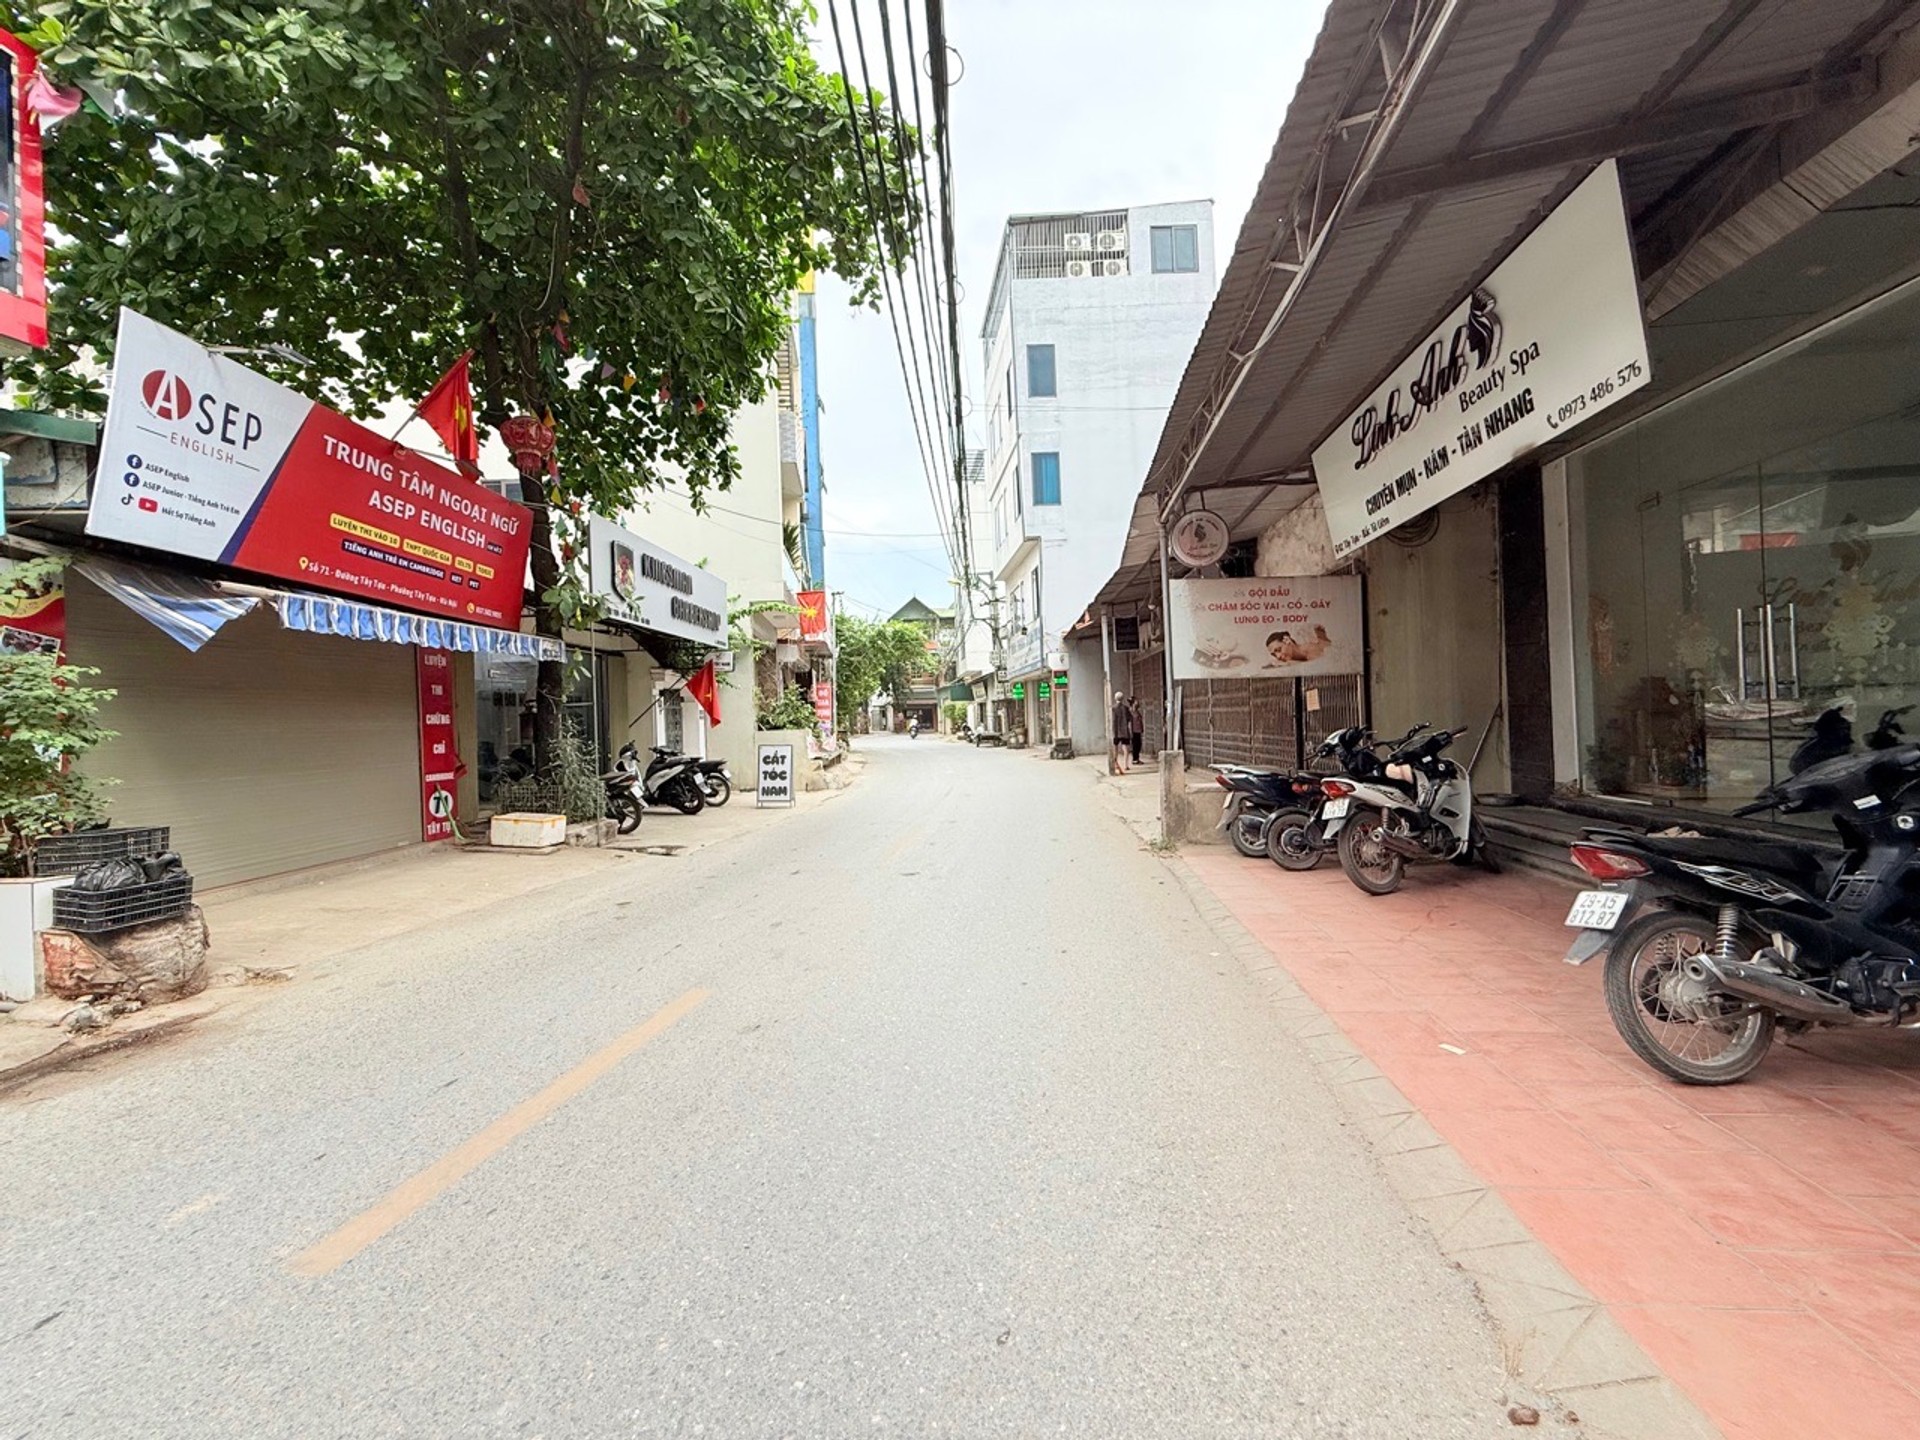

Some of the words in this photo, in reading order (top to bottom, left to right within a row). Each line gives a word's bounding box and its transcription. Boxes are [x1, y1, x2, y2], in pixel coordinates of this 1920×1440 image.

[1458, 365, 1506, 413] Beauty
[1509, 341, 1540, 376] Spa
[1352, 388, 1400, 470] Linh
[1400, 324, 1468, 432] Anh
[1558, 395, 1587, 422] 0973
[1589, 377, 1614, 402] 486
[1616, 359, 1642, 388] 576
[150, 368, 262, 450] ASEP
[170, 432, 234, 465] ENGLISH
[1365, 482, 1397, 516] CHUYÊN
[1395, 468, 1418, 496] MỤN
[1423, 445, 1450, 479] NÁM
[1456, 426, 1484, 456] TÀN
[1483, 387, 1535, 440] NHANG
[145, 463, 164, 474] ASEP
[164, 469, 190, 482] English
[323, 435, 394, 482] TRUNG
[399, 470, 435, 500] TÂM
[439, 489, 487, 523] NGOẠI
[490, 512, 520, 536] NGỮ
[142, 480, 161, 492] ASEP
[162, 487, 184, 499] Junior
[188, 493, 206, 506] Tiếng
[207, 500, 219, 509] Anh
[230, 506, 241, 515] Em
[184, 513, 203, 526] Tiếng
[203, 519, 216, 528] Anh
[369, 491, 416, 520] ASEP
[420, 511, 486, 548] ENGLISH
[333, 517, 358, 532] LUYỆN
[359, 526, 373, 536] THI
[373, 531, 388, 542] VÀO
[389, 536, 398, 545] 10
[344, 541, 368, 555] TIẾNG
[368, 549, 384, 560] ANH
[385, 553, 397, 564] TRẺ
[398, 558, 408, 567] EM
[409, 560, 445, 578] CAMBRIDGE
[406, 541, 422, 553] THPT
[422, 546, 439, 560] QUỐC
[439, 554, 450, 563] GIA
[308, 562, 319, 573] Số
[320, 565, 330, 576] 71
[335, 569, 359, 585] Đường
[360, 575, 373, 589] Tây
[390, 583, 414, 599] Phường
[1248, 588, 1267, 600] GỘI
[1269, 585, 1290, 597] ĐẦU
[1208, 601, 1238, 611] CHĂM
[1240, 599, 1261, 611] SÓC
[1264, 601, 1280, 610] VAI
[1287, 597, 1303, 610] CỔ
[1234, 614, 1260, 625] LƯNG
[1262, 615, 1275, 624] EO
[1283, 614, 1308, 624] BODY
[424, 654, 447, 669] LUYỆN
[431, 684, 443, 696] THI
[426, 712, 451, 725] CHỨNG
[433, 740, 446, 754] CHỈ
[762, 750, 787, 765] CẮT
[762, 767, 787, 781] TÓC
[761, 786, 788, 796] NAM
